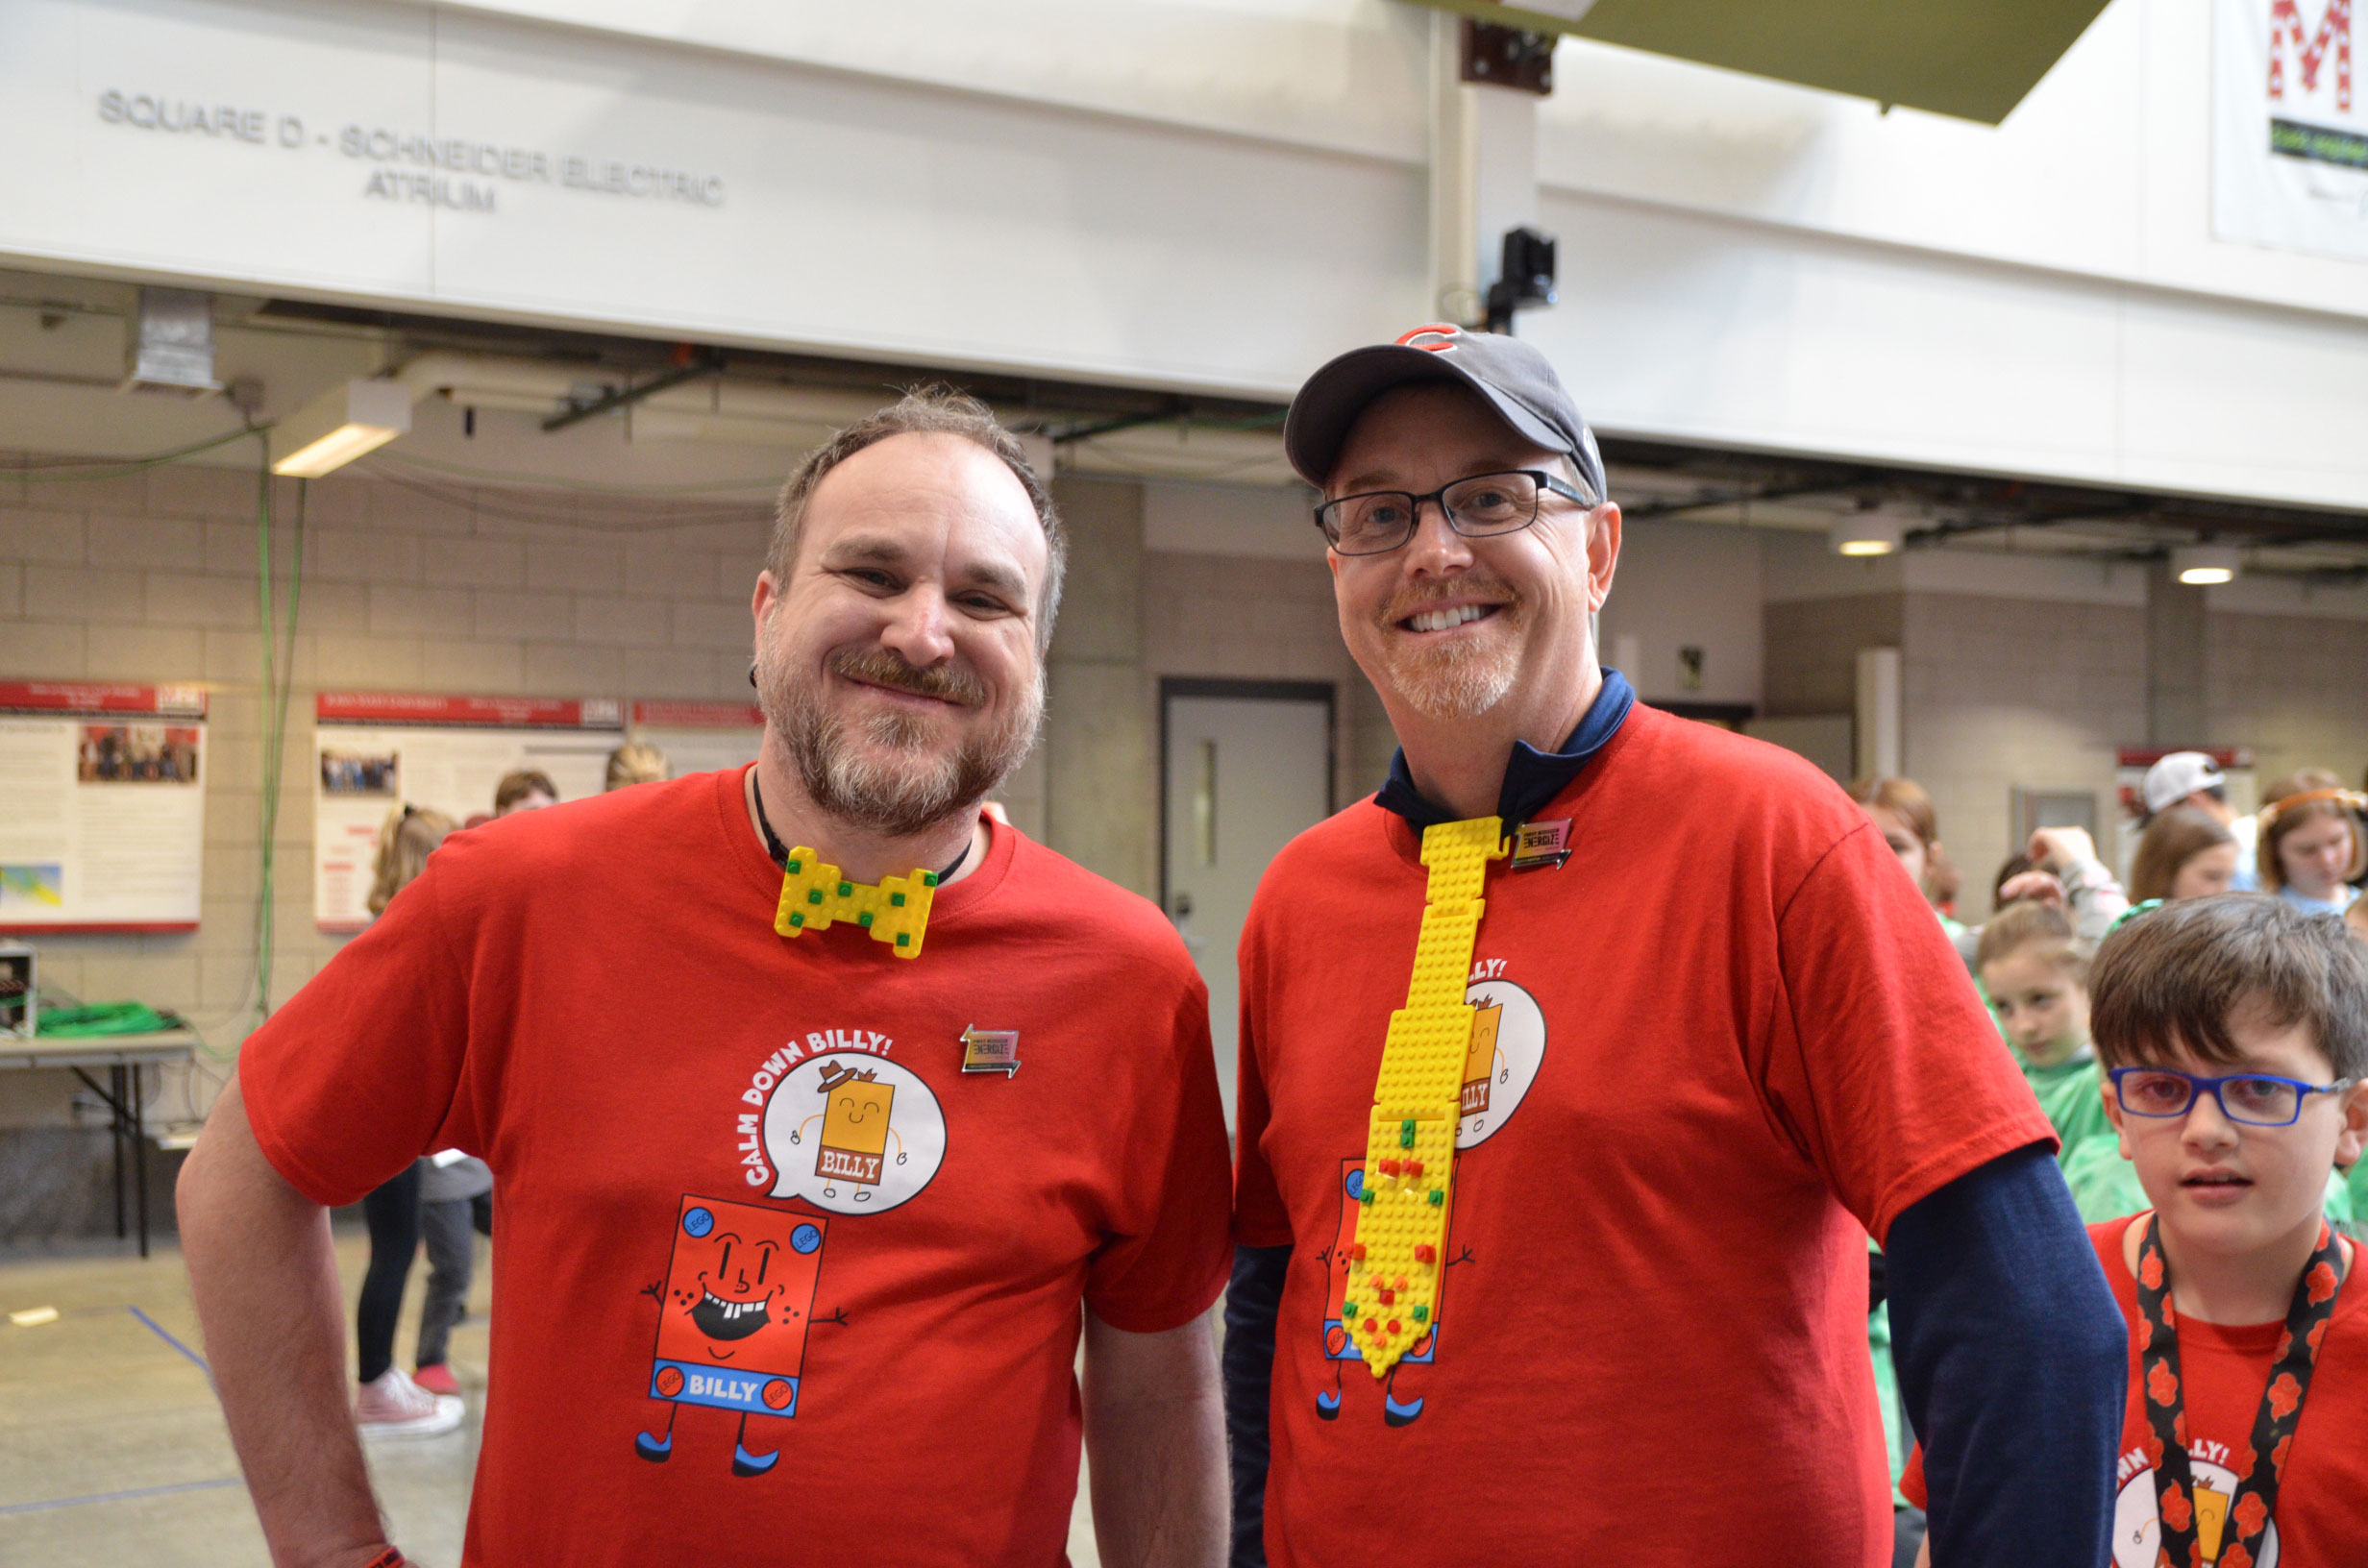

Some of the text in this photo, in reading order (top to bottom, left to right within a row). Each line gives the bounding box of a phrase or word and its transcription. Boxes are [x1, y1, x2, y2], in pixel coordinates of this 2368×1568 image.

[98, 88, 266, 145] SQUARE
[278, 115, 304, 149] D
[339, 123, 550, 184] SCHNEIDER
[561, 154, 728, 208] ELECTRIC
[364, 169, 497, 213] ATRIUM
[1468, 958, 1507, 983] LY!
[737, 1029, 893, 1187] CALM DOWN BILLY!
[1461, 1082, 1489, 1111] ILLY
[821, 1150, 880, 1180] BILLY
[686, 1212, 711, 1233] LEGO
[795, 1228, 819, 1249] LEGO
[659, 1371, 681, 1392] LEGO
[689, 1374, 758, 1403] BILLY
[764, 1384, 789, 1406] LEGO
[2187, 1438, 2231, 1465] LY!
